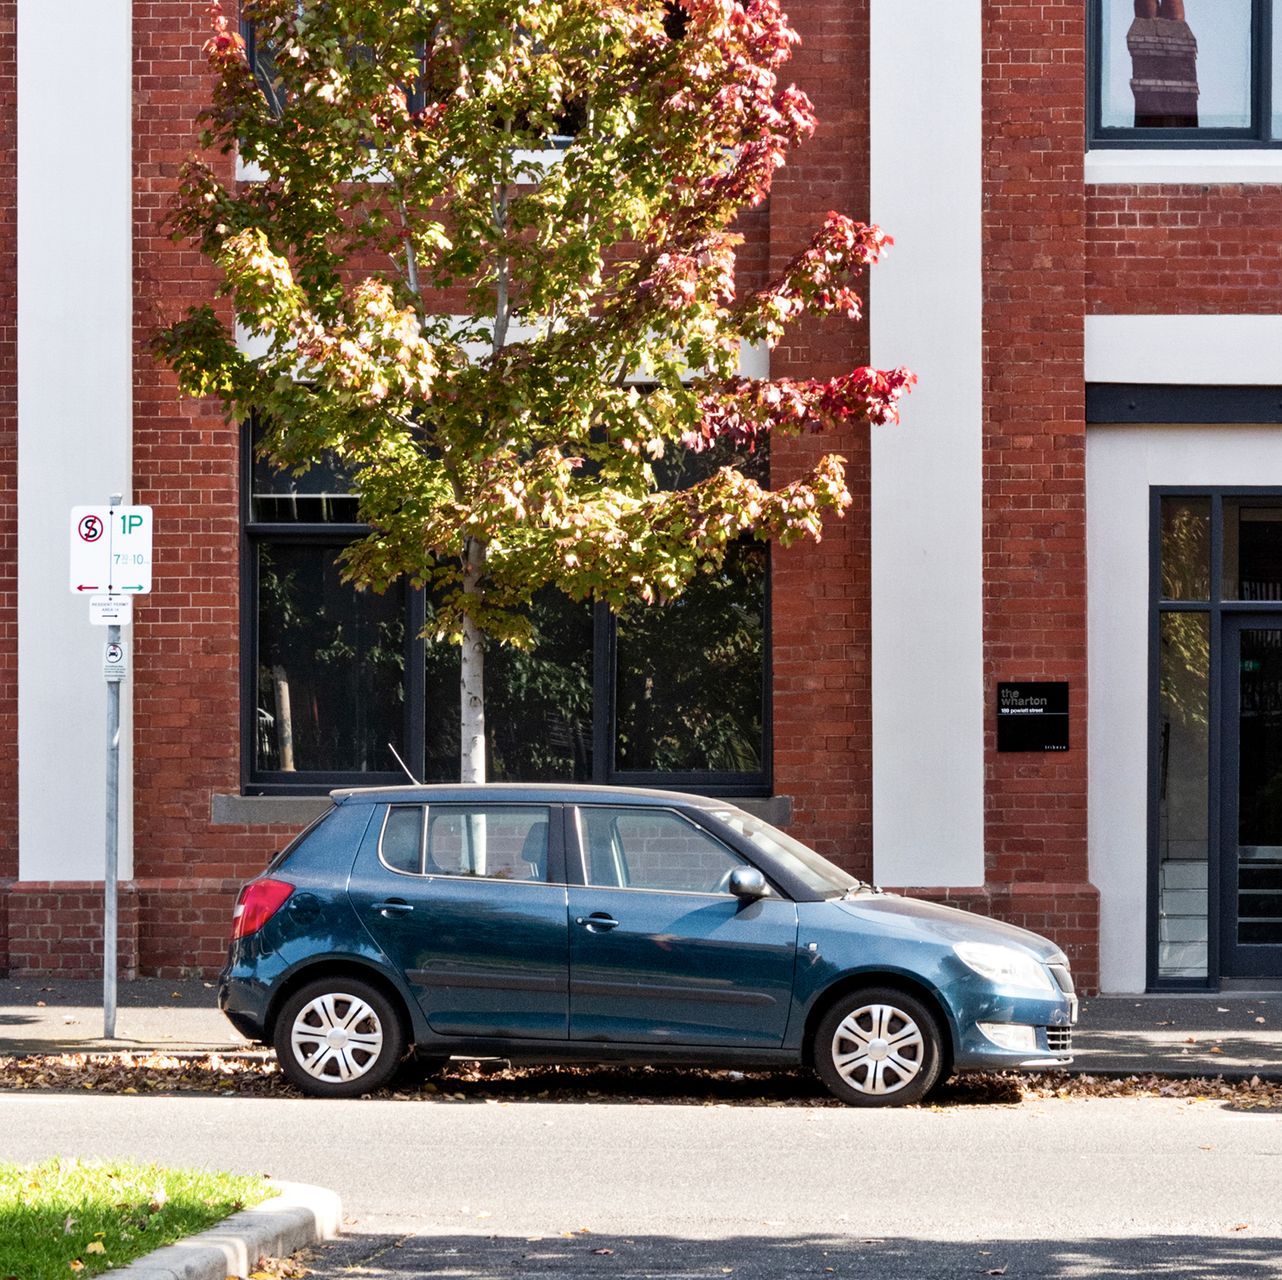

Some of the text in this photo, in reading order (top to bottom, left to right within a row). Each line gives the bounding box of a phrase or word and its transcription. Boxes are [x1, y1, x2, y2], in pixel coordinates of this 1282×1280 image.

[121, 515, 143, 535] 1P
[1001, 689, 1020, 698] the
[1001, 696, 1048, 706] wharton
